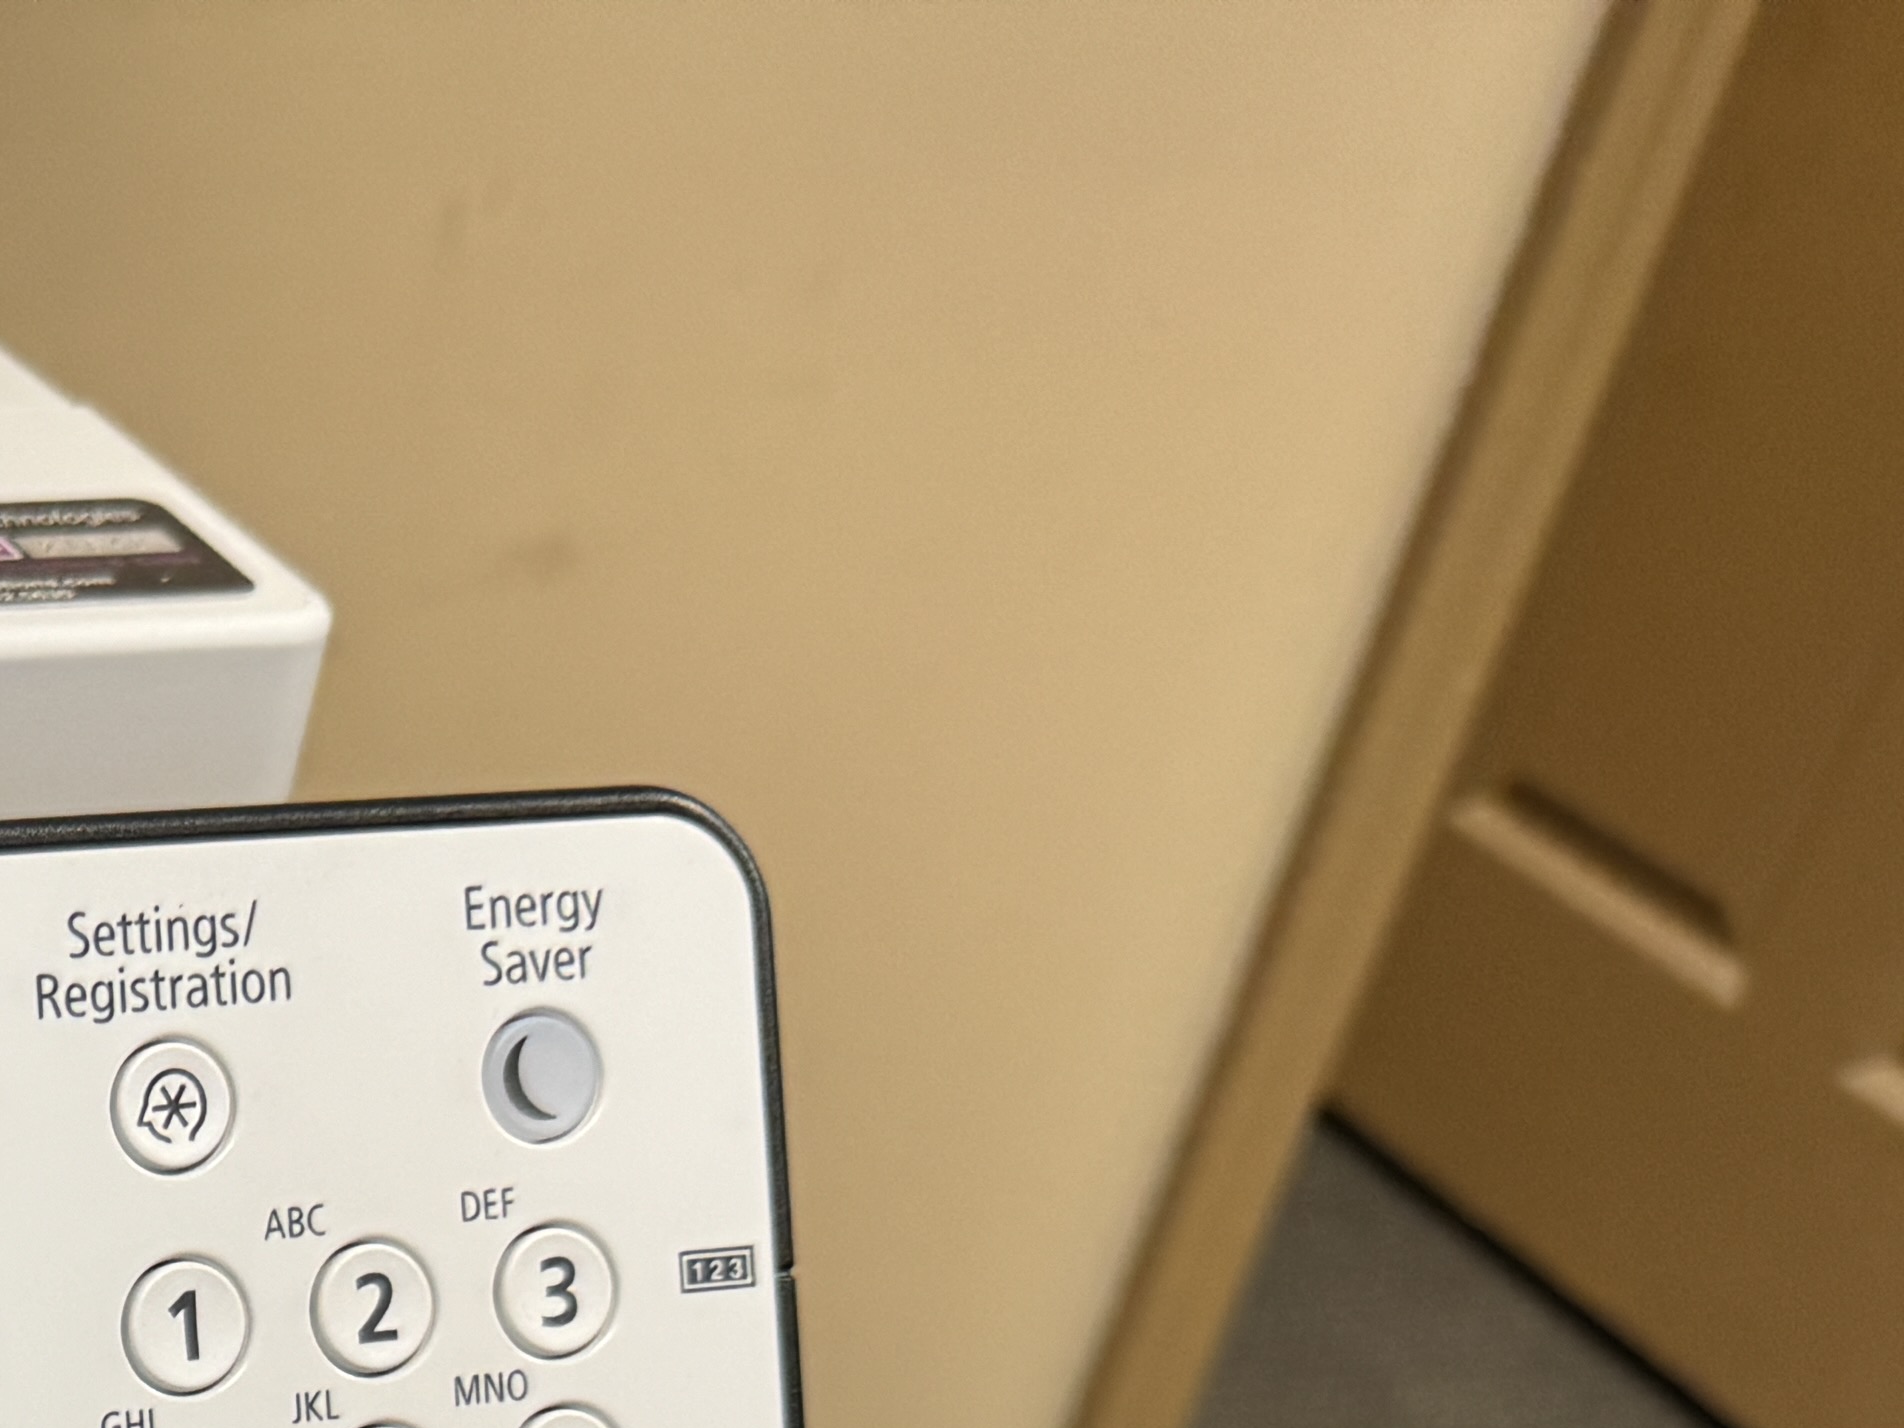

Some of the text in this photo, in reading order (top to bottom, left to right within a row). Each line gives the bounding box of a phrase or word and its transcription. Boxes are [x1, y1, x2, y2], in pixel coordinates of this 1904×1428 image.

[67, 900, 258, 959] Settings/
[465, 885, 603, 932] Energy
[481, 940, 593, 987] Saver
[35, 961, 293, 1023] Registration
[264, 1204, 327, 1241] ABC
[460, 1187, 516, 1223] DEF
[354, 1272, 399, 1345] 2
[539, 1255, 579, 1328] 3
[167, 1289, 202, 1362] 1
[291, 1389, 341, 1425] JKL
[454, 1369, 529, 1407] MNO
